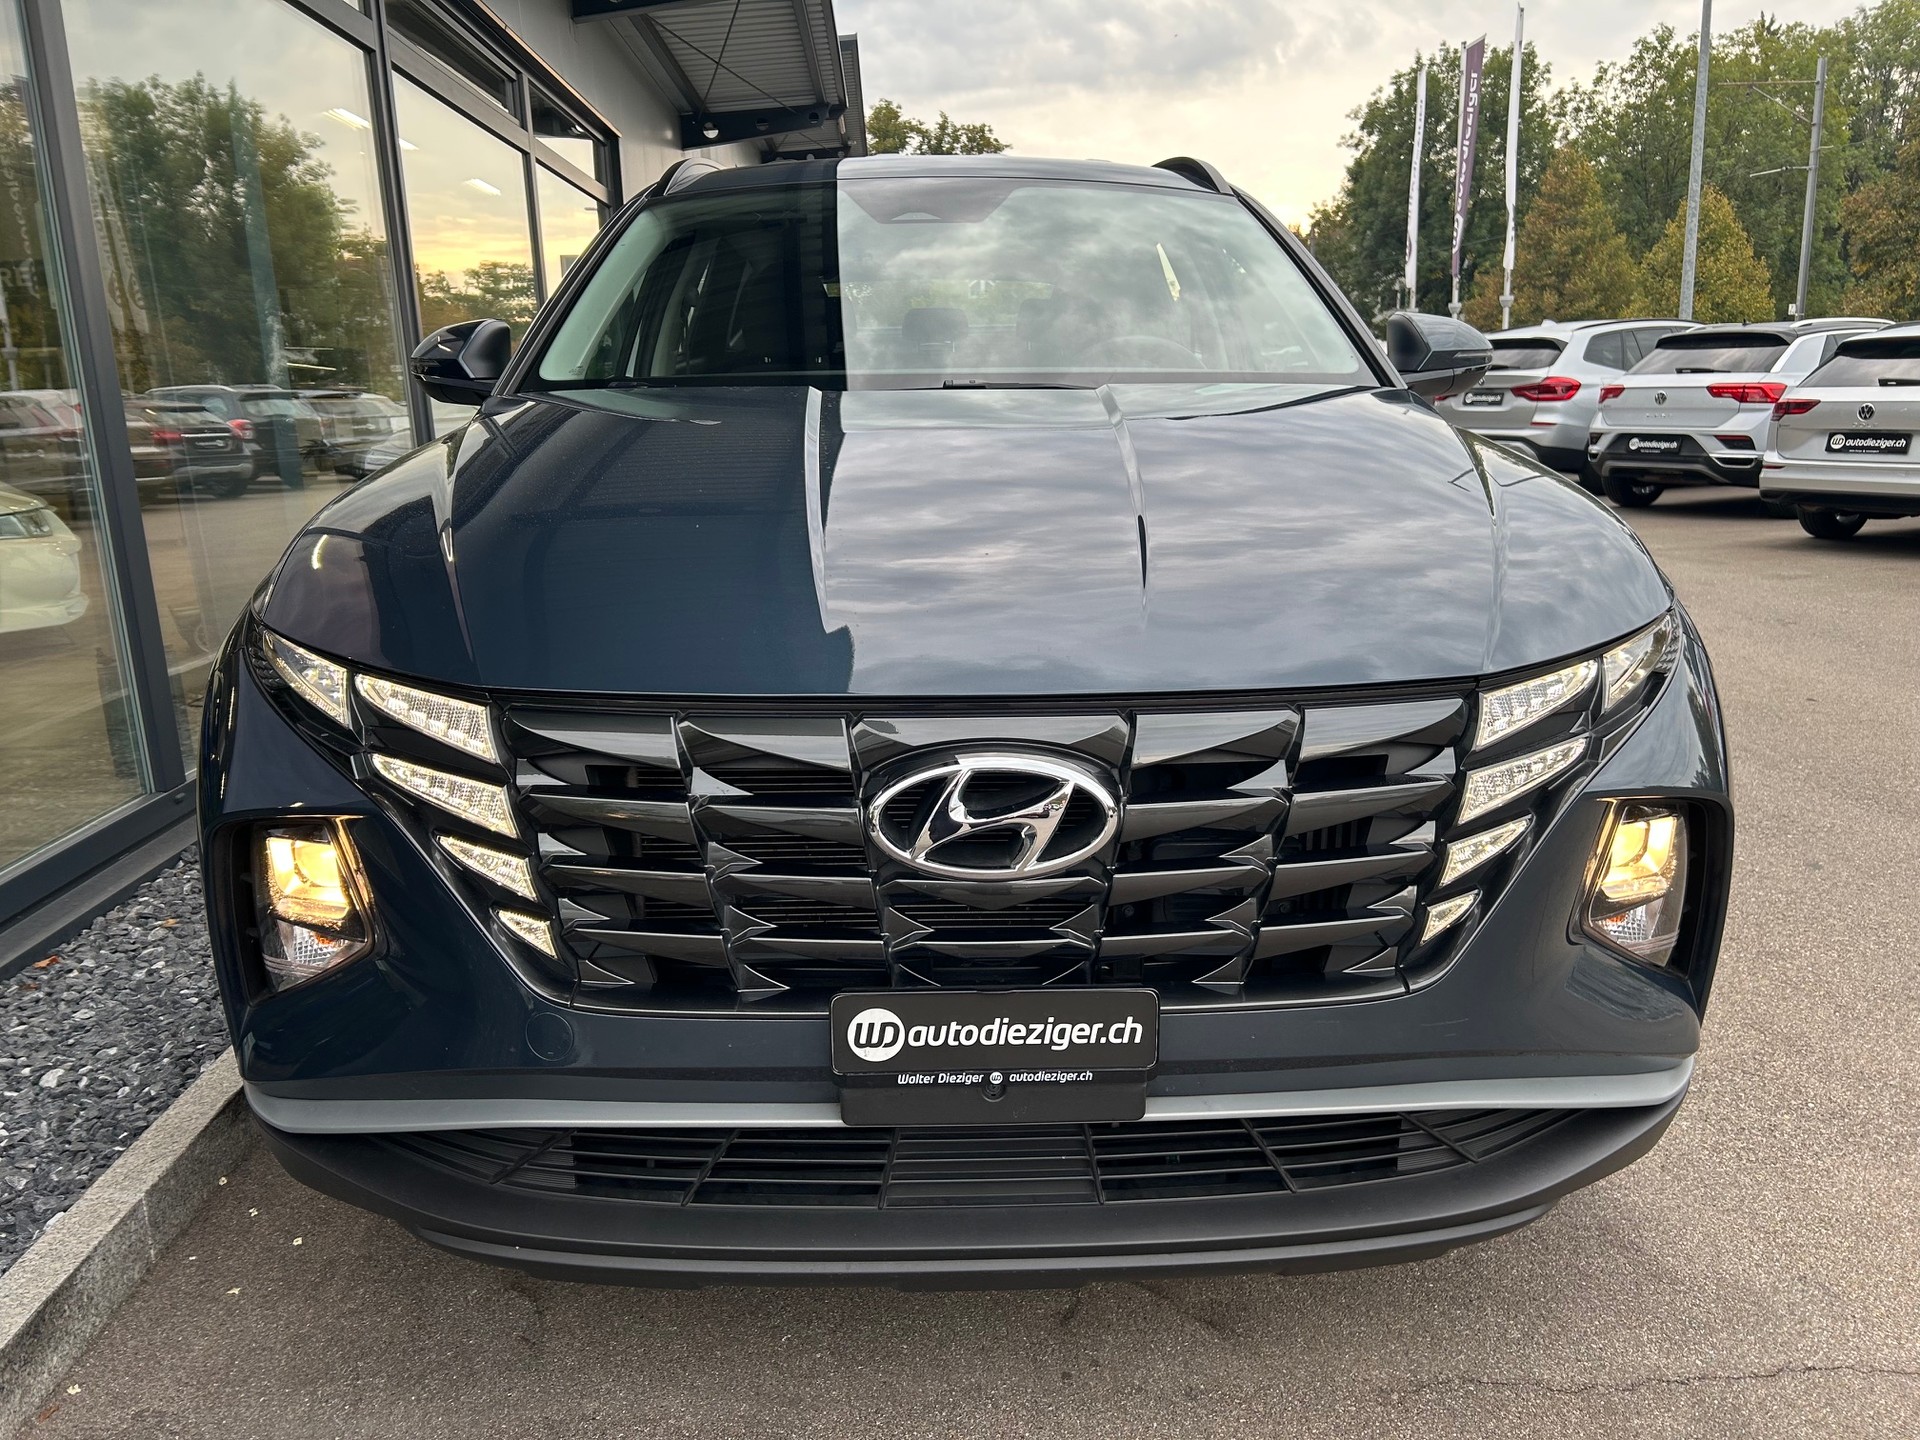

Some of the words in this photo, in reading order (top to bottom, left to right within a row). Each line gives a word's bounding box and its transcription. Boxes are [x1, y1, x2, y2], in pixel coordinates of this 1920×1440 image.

[1845, 438, 1906, 449] autodieziger.ch
[908, 1016, 1143, 1051] autodieziger.ch
[897, 1073, 935, 1084] Walter
[938, 1073, 984, 1085] Dieziger
[1009, 1071, 1093, 1083] autodieziger.ch
